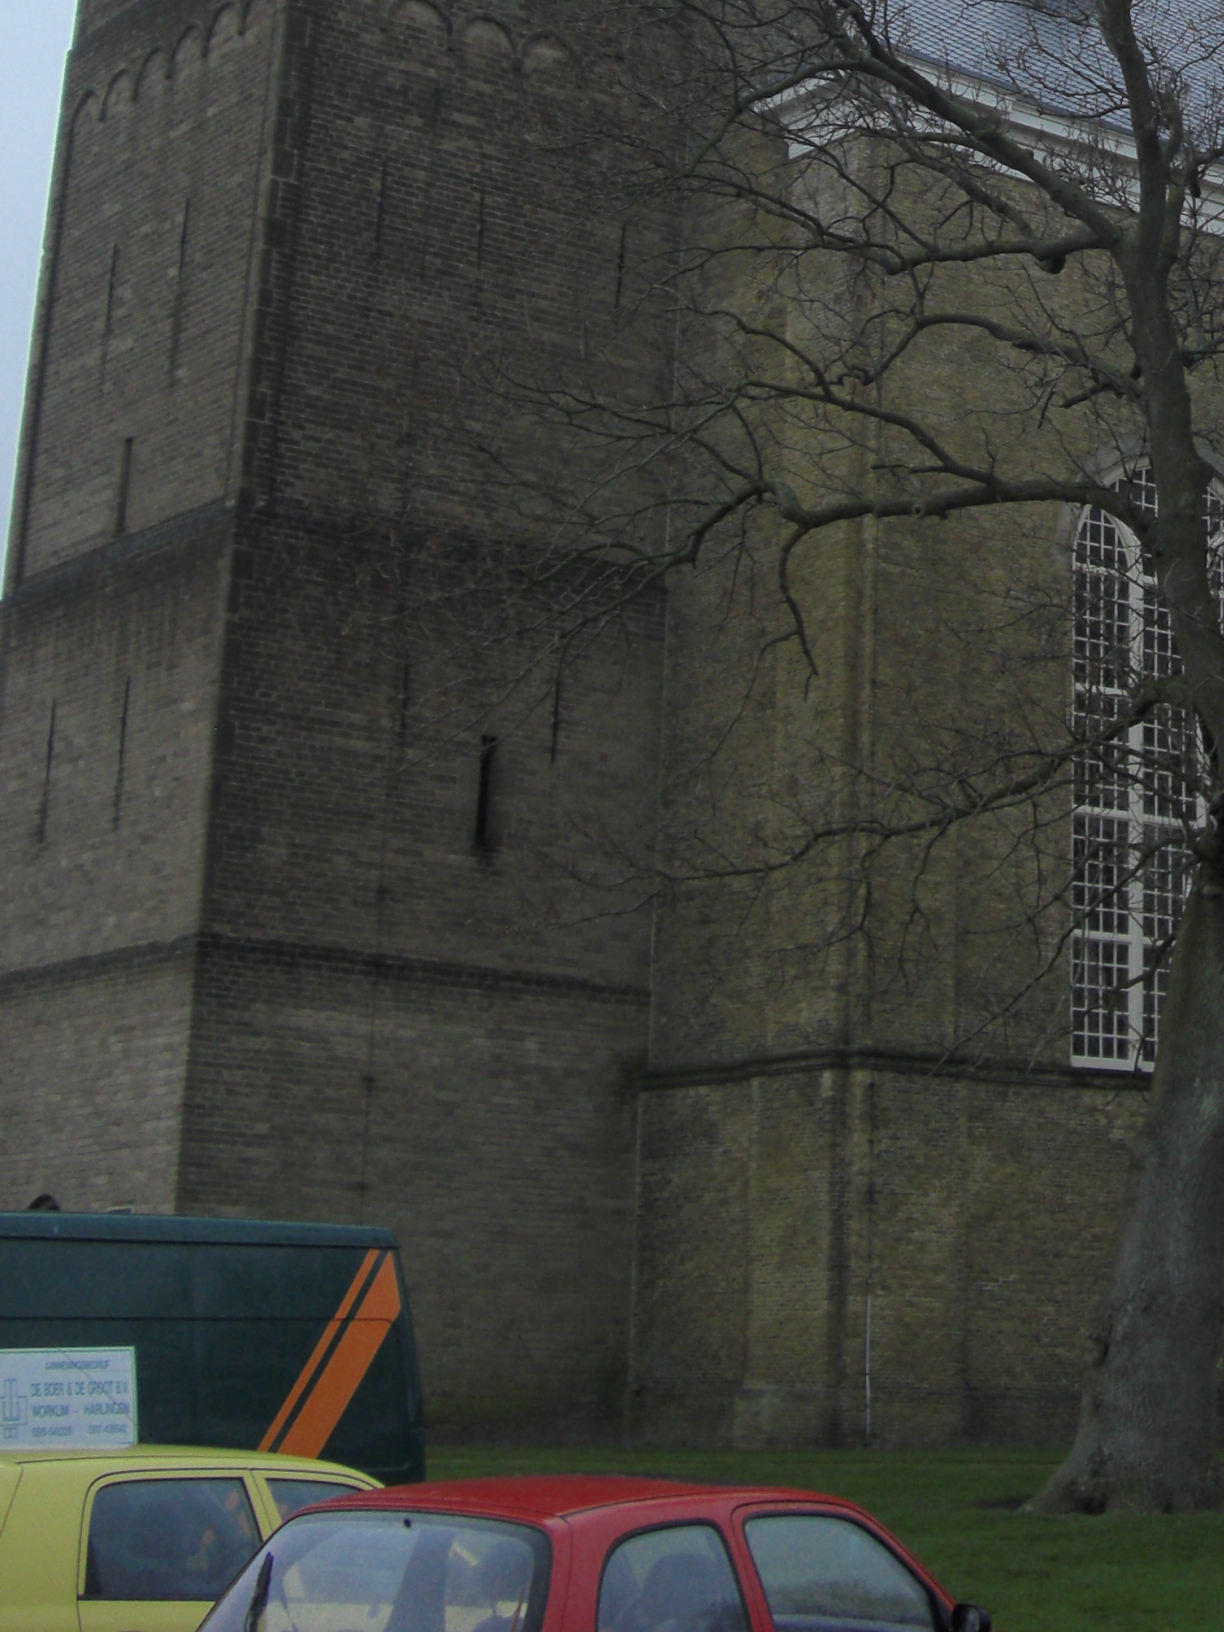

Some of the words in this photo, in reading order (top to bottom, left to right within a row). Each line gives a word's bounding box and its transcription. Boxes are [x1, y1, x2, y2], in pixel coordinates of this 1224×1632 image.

[30, 1382, 41, 1397] DE
[43, 1382, 64, 1397] BOER
[75, 1381, 85, 1396] DE
[32, 1404, 69, 1417] WORKUM
[83, 1402, 129, 1415] HARLINGEN
